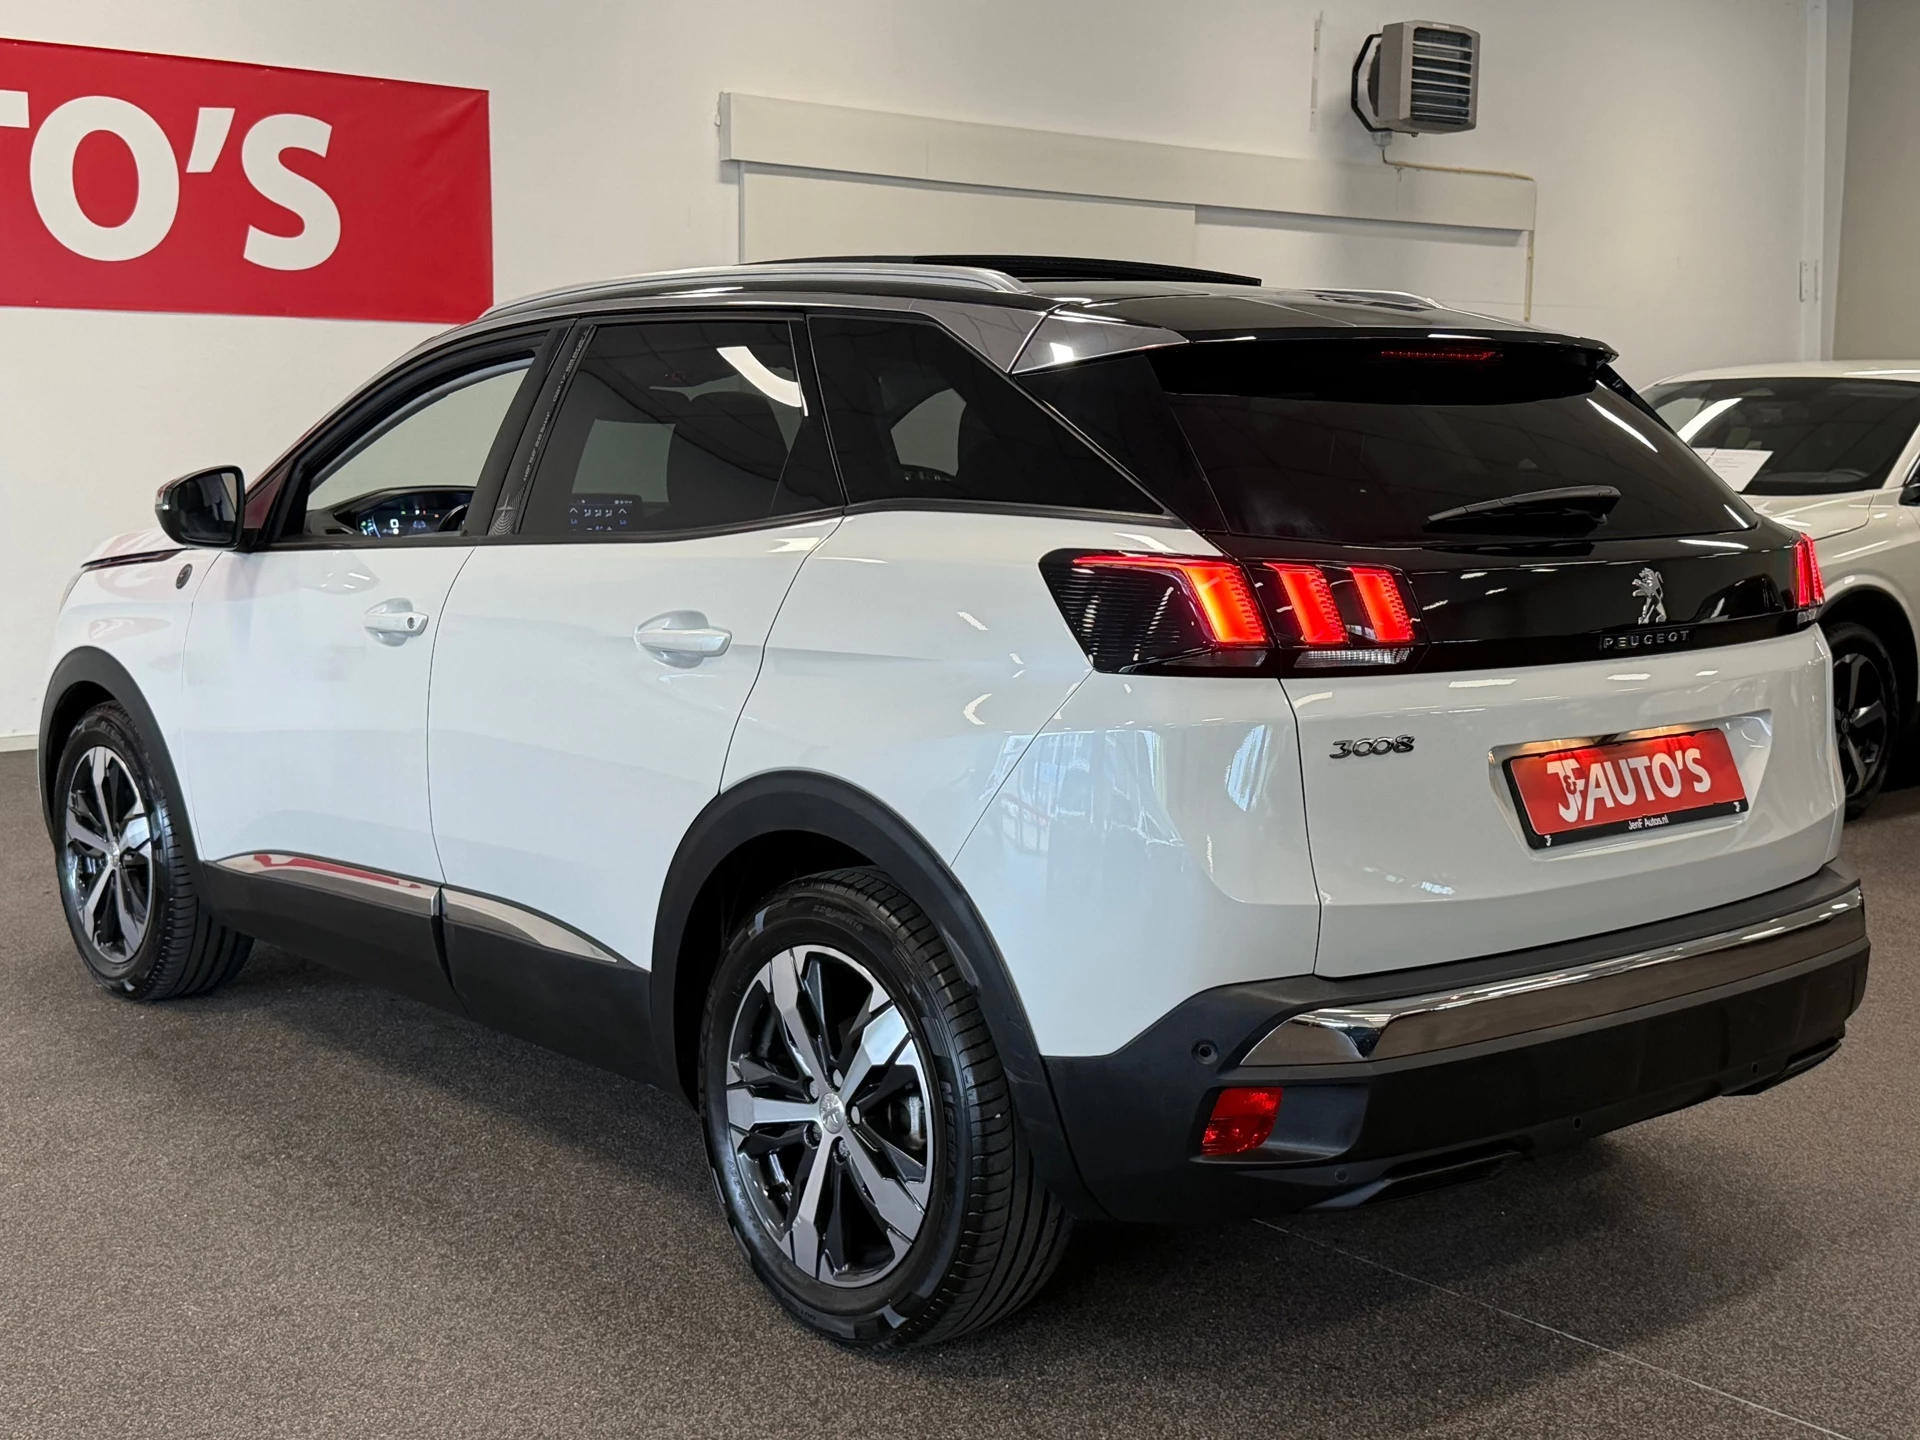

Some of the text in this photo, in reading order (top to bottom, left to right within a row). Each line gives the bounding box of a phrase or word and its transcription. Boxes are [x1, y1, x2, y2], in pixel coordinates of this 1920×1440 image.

[0, 90, 341, 271] O'S
[1603, 630, 1690, 649] PEUGEOT
[1329, 734, 1415, 759] 3008
[1584, 748, 1711, 821] AUTO'S
[1644, 814, 1669, 827] Autos.nl
